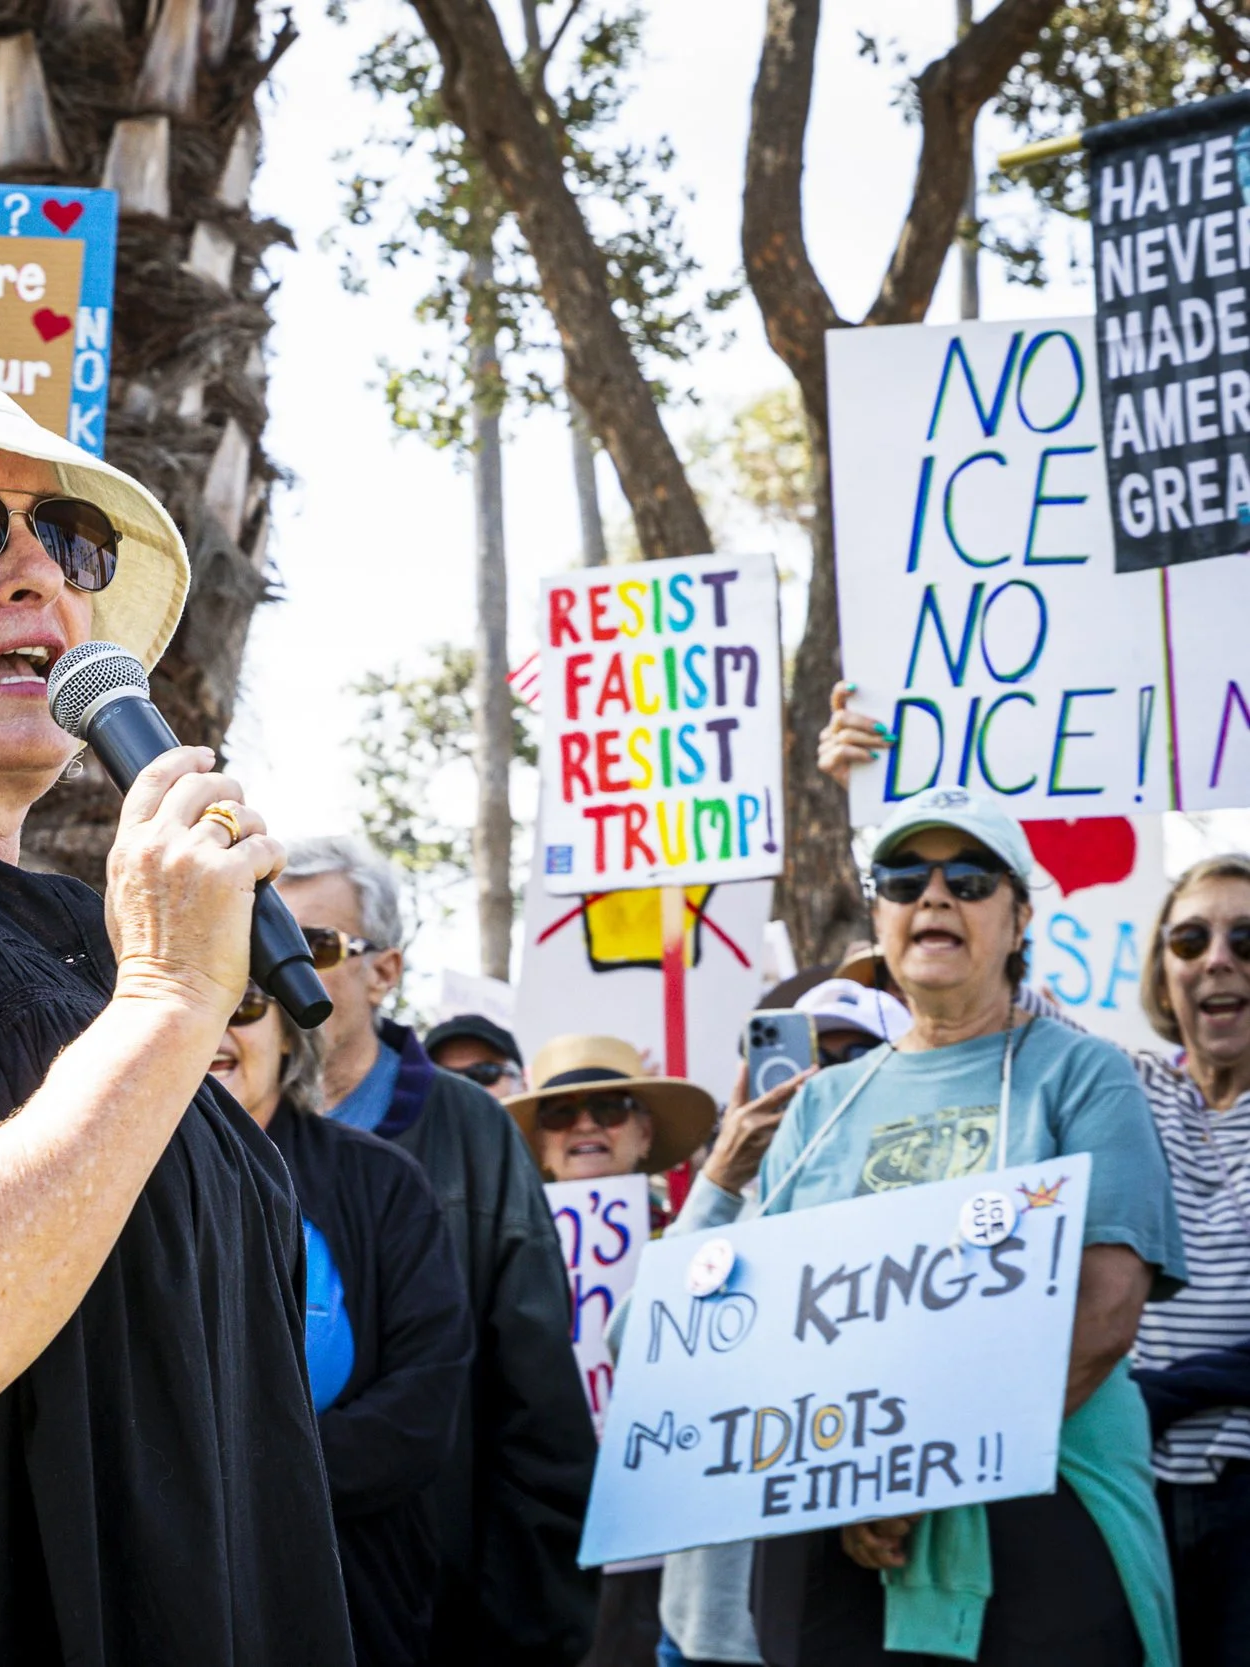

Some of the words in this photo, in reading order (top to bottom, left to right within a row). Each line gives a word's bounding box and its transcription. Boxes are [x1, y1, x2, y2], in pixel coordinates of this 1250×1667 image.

[1100, 135, 1234, 225] HATE
[73, 306, 109, 392] NO
[1105, 286, 1249, 380] MADE
[926, 329, 1085, 441] NO
[906, 445, 1097, 573] ICE
[550, 570, 738, 647] RESIST
[905, 580, 1049, 689] NO
[565, 645, 758, 720] FACISM
[560, 718, 739, 803] RESIST
[583, 786, 778, 874] TRUMP!
[647, 1291, 757, 1364] NO
[703, 1389, 906, 1476] IDIOTS
